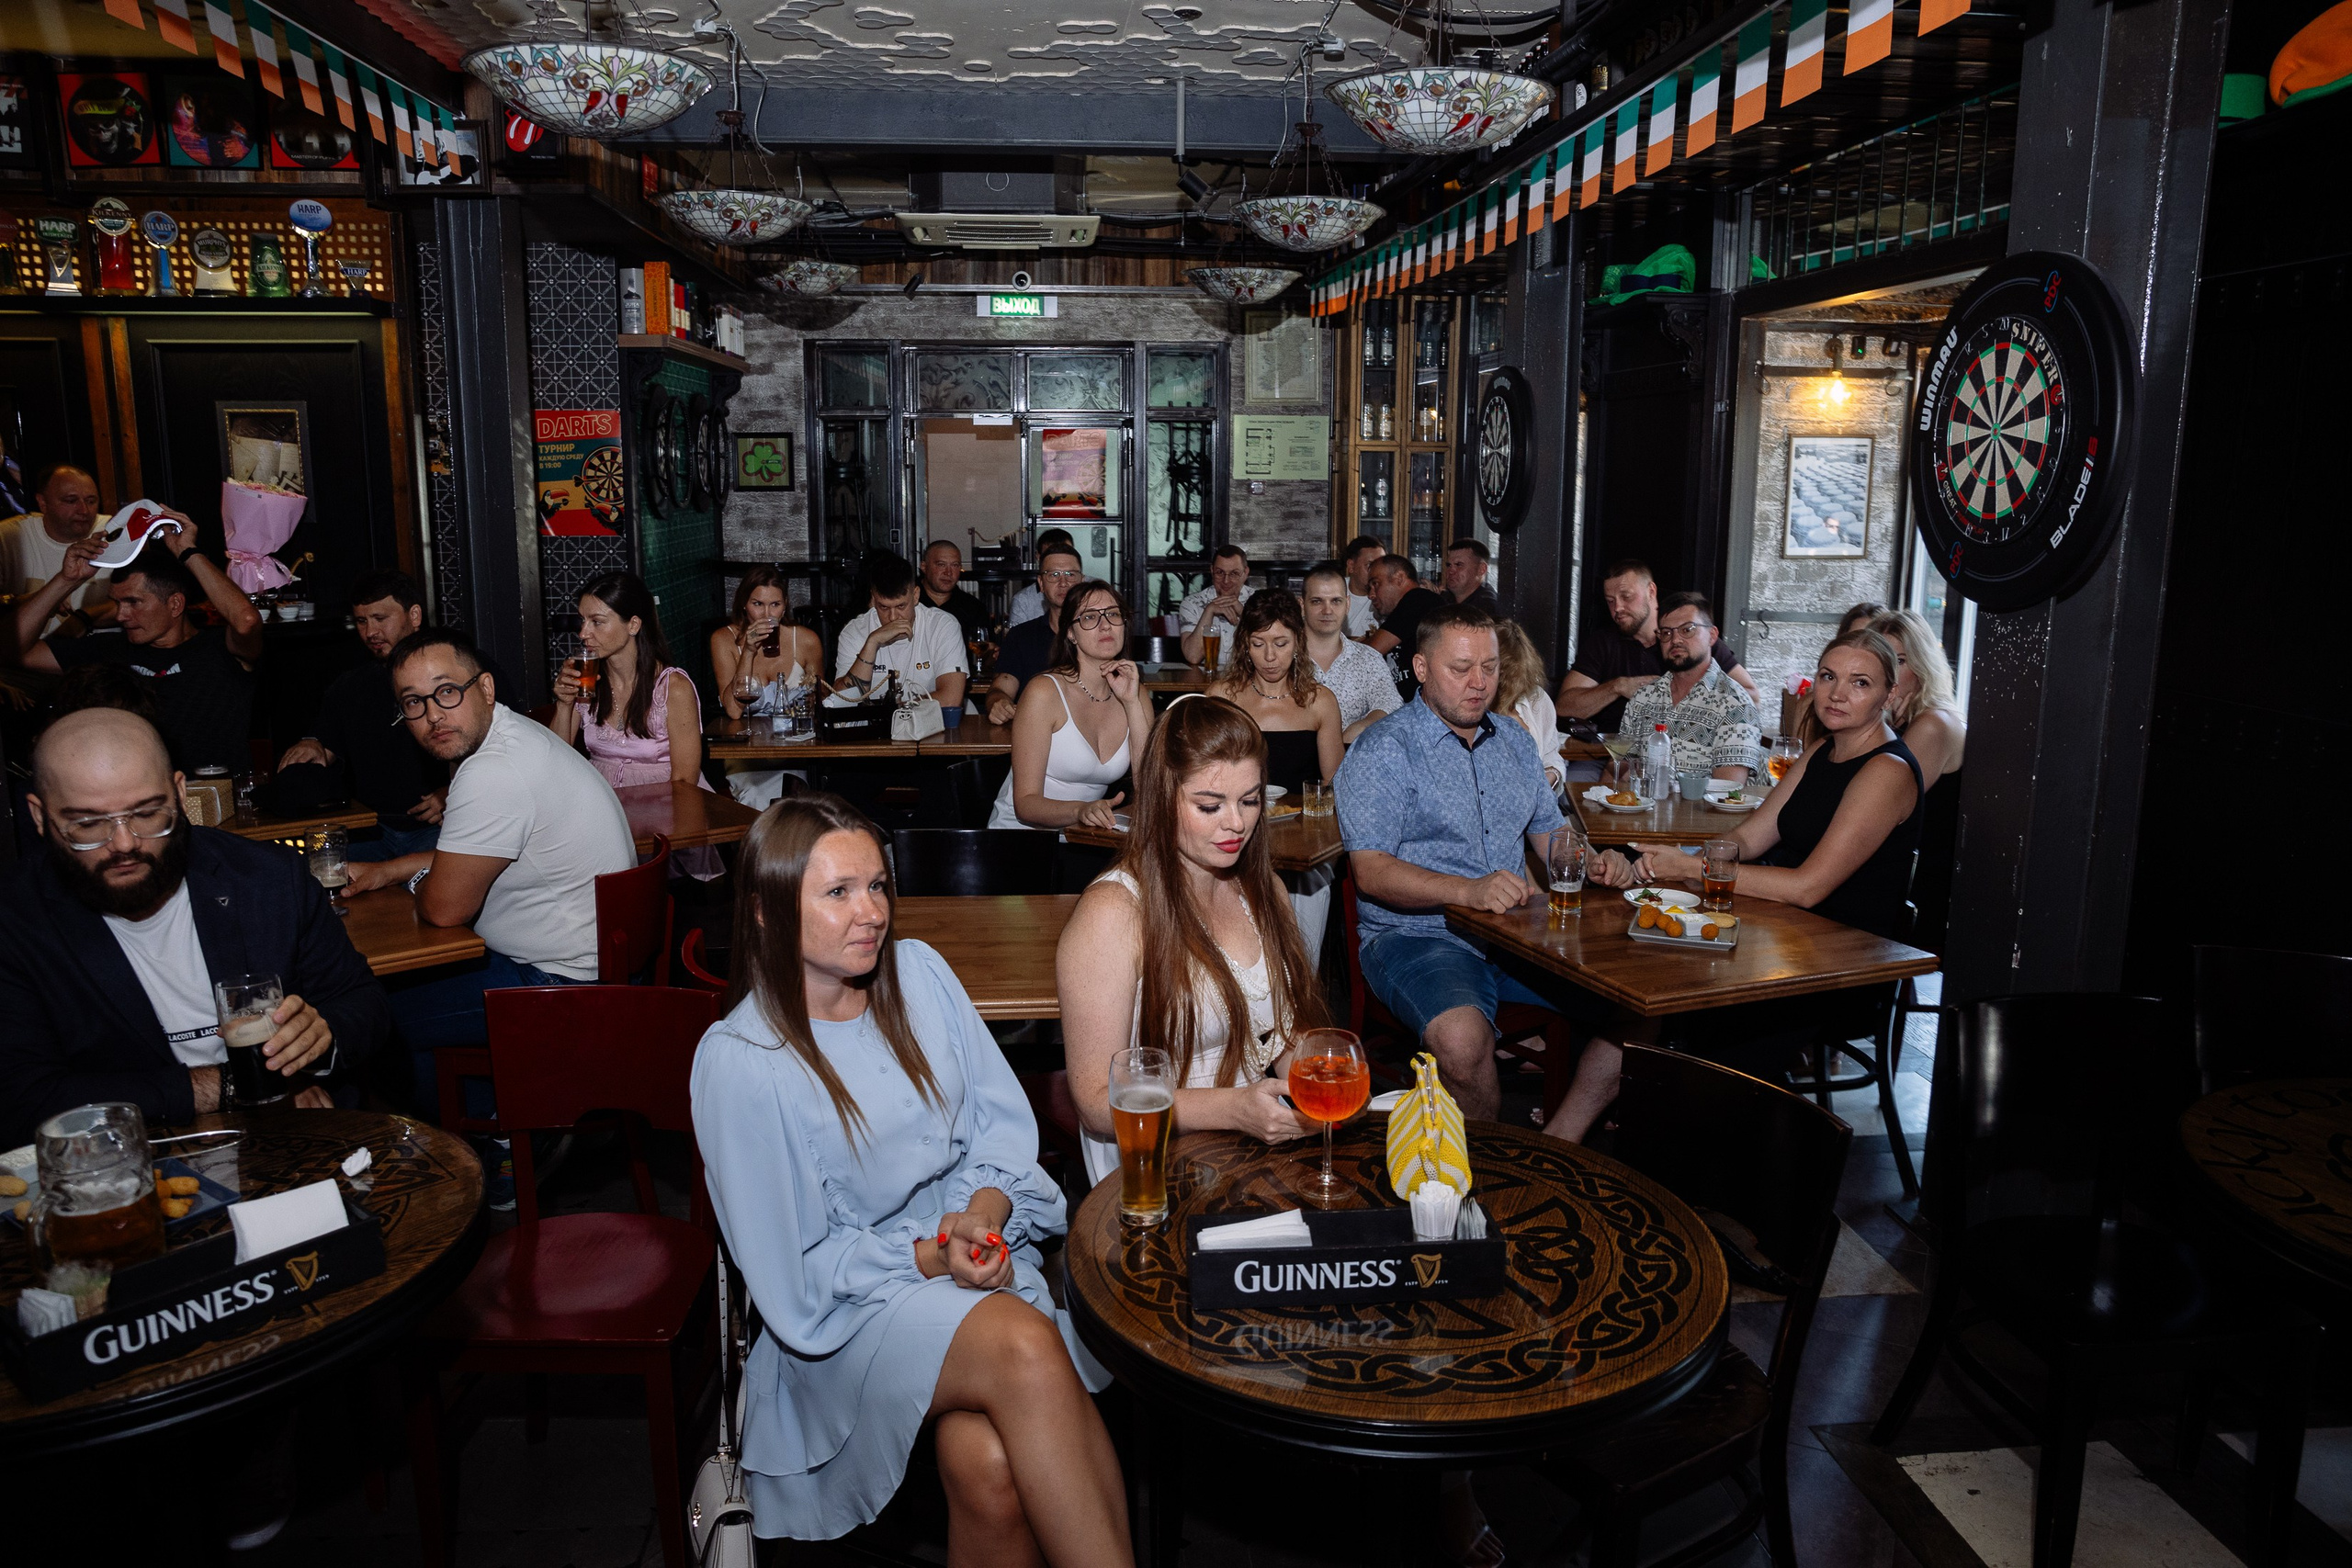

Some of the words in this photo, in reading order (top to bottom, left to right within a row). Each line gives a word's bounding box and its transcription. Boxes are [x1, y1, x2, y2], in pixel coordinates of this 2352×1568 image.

[92, 209, 132, 219] KILKENNY
[297, 204, 322, 215] HARP
[39, 220, 76, 233] HARP
[147, 221, 175, 231] HARP
[347, 267, 368, 276] HARP
[2044, 274, 2063, 309] PDC
[992, 297, 1041, 316] ВЫХОД
[2011, 321, 2059, 386] SNIPER
[1919, 326, 1958, 432] WINMAU
[537, 413, 612, 439] DARTS
[538, 443, 575, 454] ТУРНИР
[566, 453, 584, 461] СРЕДУ
[545, 461, 561, 469] 19:00
[1942, 479, 1958, 509] GREAT
[2049, 466, 2092, 549] BLADE
[1949, 545, 1966, 575] PDC
[168, 1031, 197, 1042] LACOSTE
[200, 1027, 219, 1037] LACO
[1234, 1259, 1397, 1293] GUINNESS
[83, 1271, 275, 1365] GUINNESS
